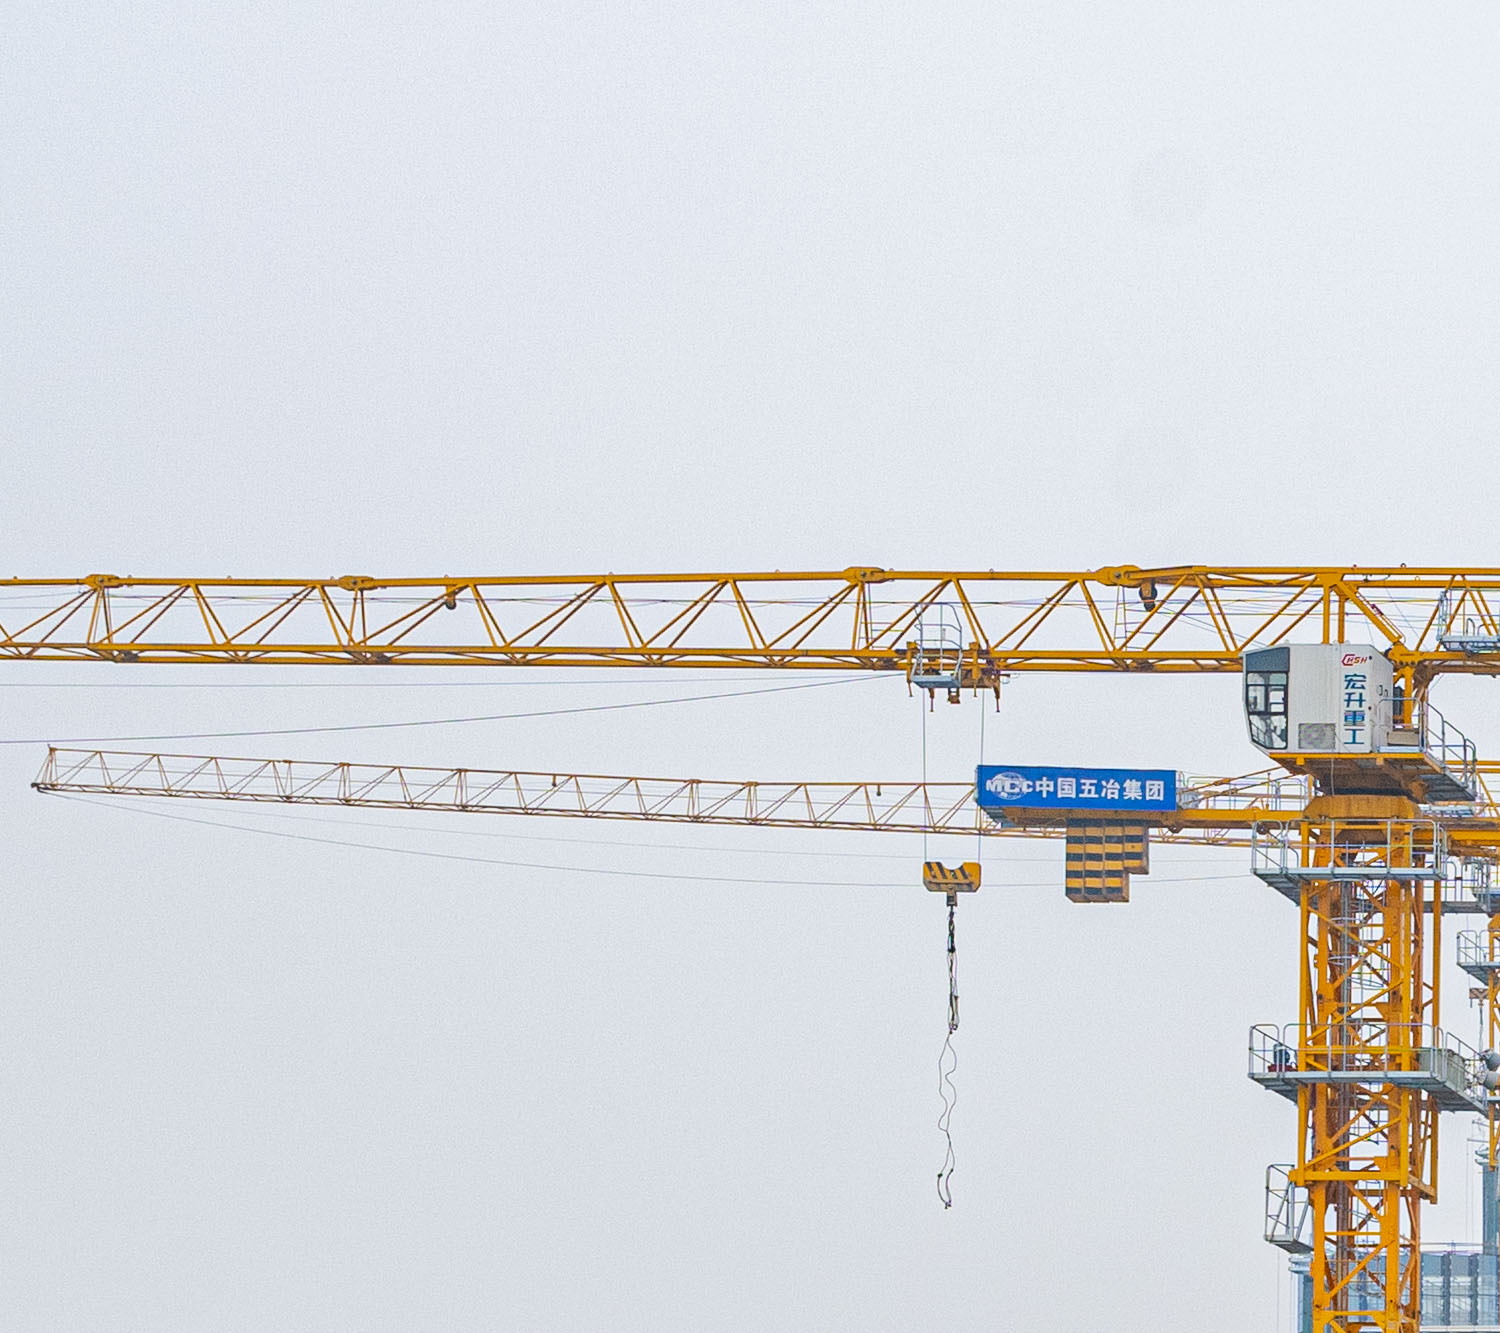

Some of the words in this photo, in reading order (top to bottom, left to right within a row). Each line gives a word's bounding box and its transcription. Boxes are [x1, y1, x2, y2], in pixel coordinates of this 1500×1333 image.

[1344, 673, 1367, 745] 宏升重工
[986, 777, 1033, 794] MCC
[1035, 776, 1165, 801] 中国五冶集团
